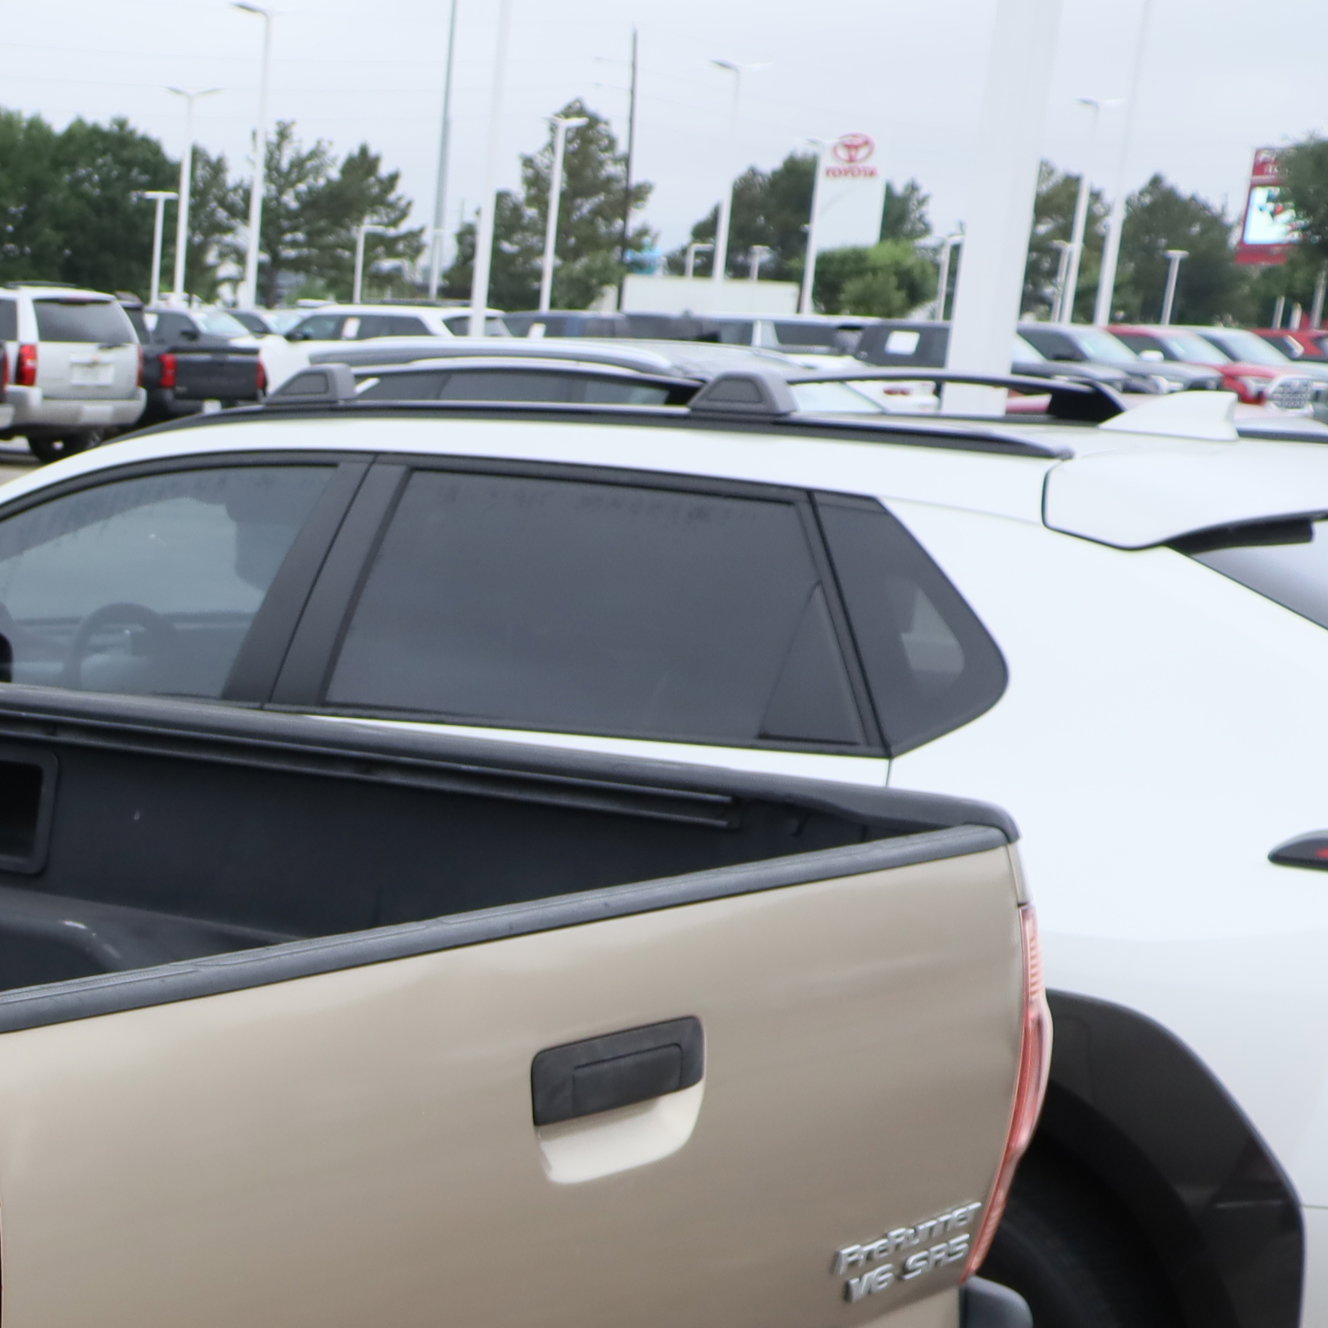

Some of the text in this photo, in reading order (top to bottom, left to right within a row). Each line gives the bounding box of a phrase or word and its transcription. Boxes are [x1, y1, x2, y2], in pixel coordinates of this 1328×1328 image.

[825, 165, 879, 177] TOYOTA
[846, 1233, 971, 1302] V6 SR5
